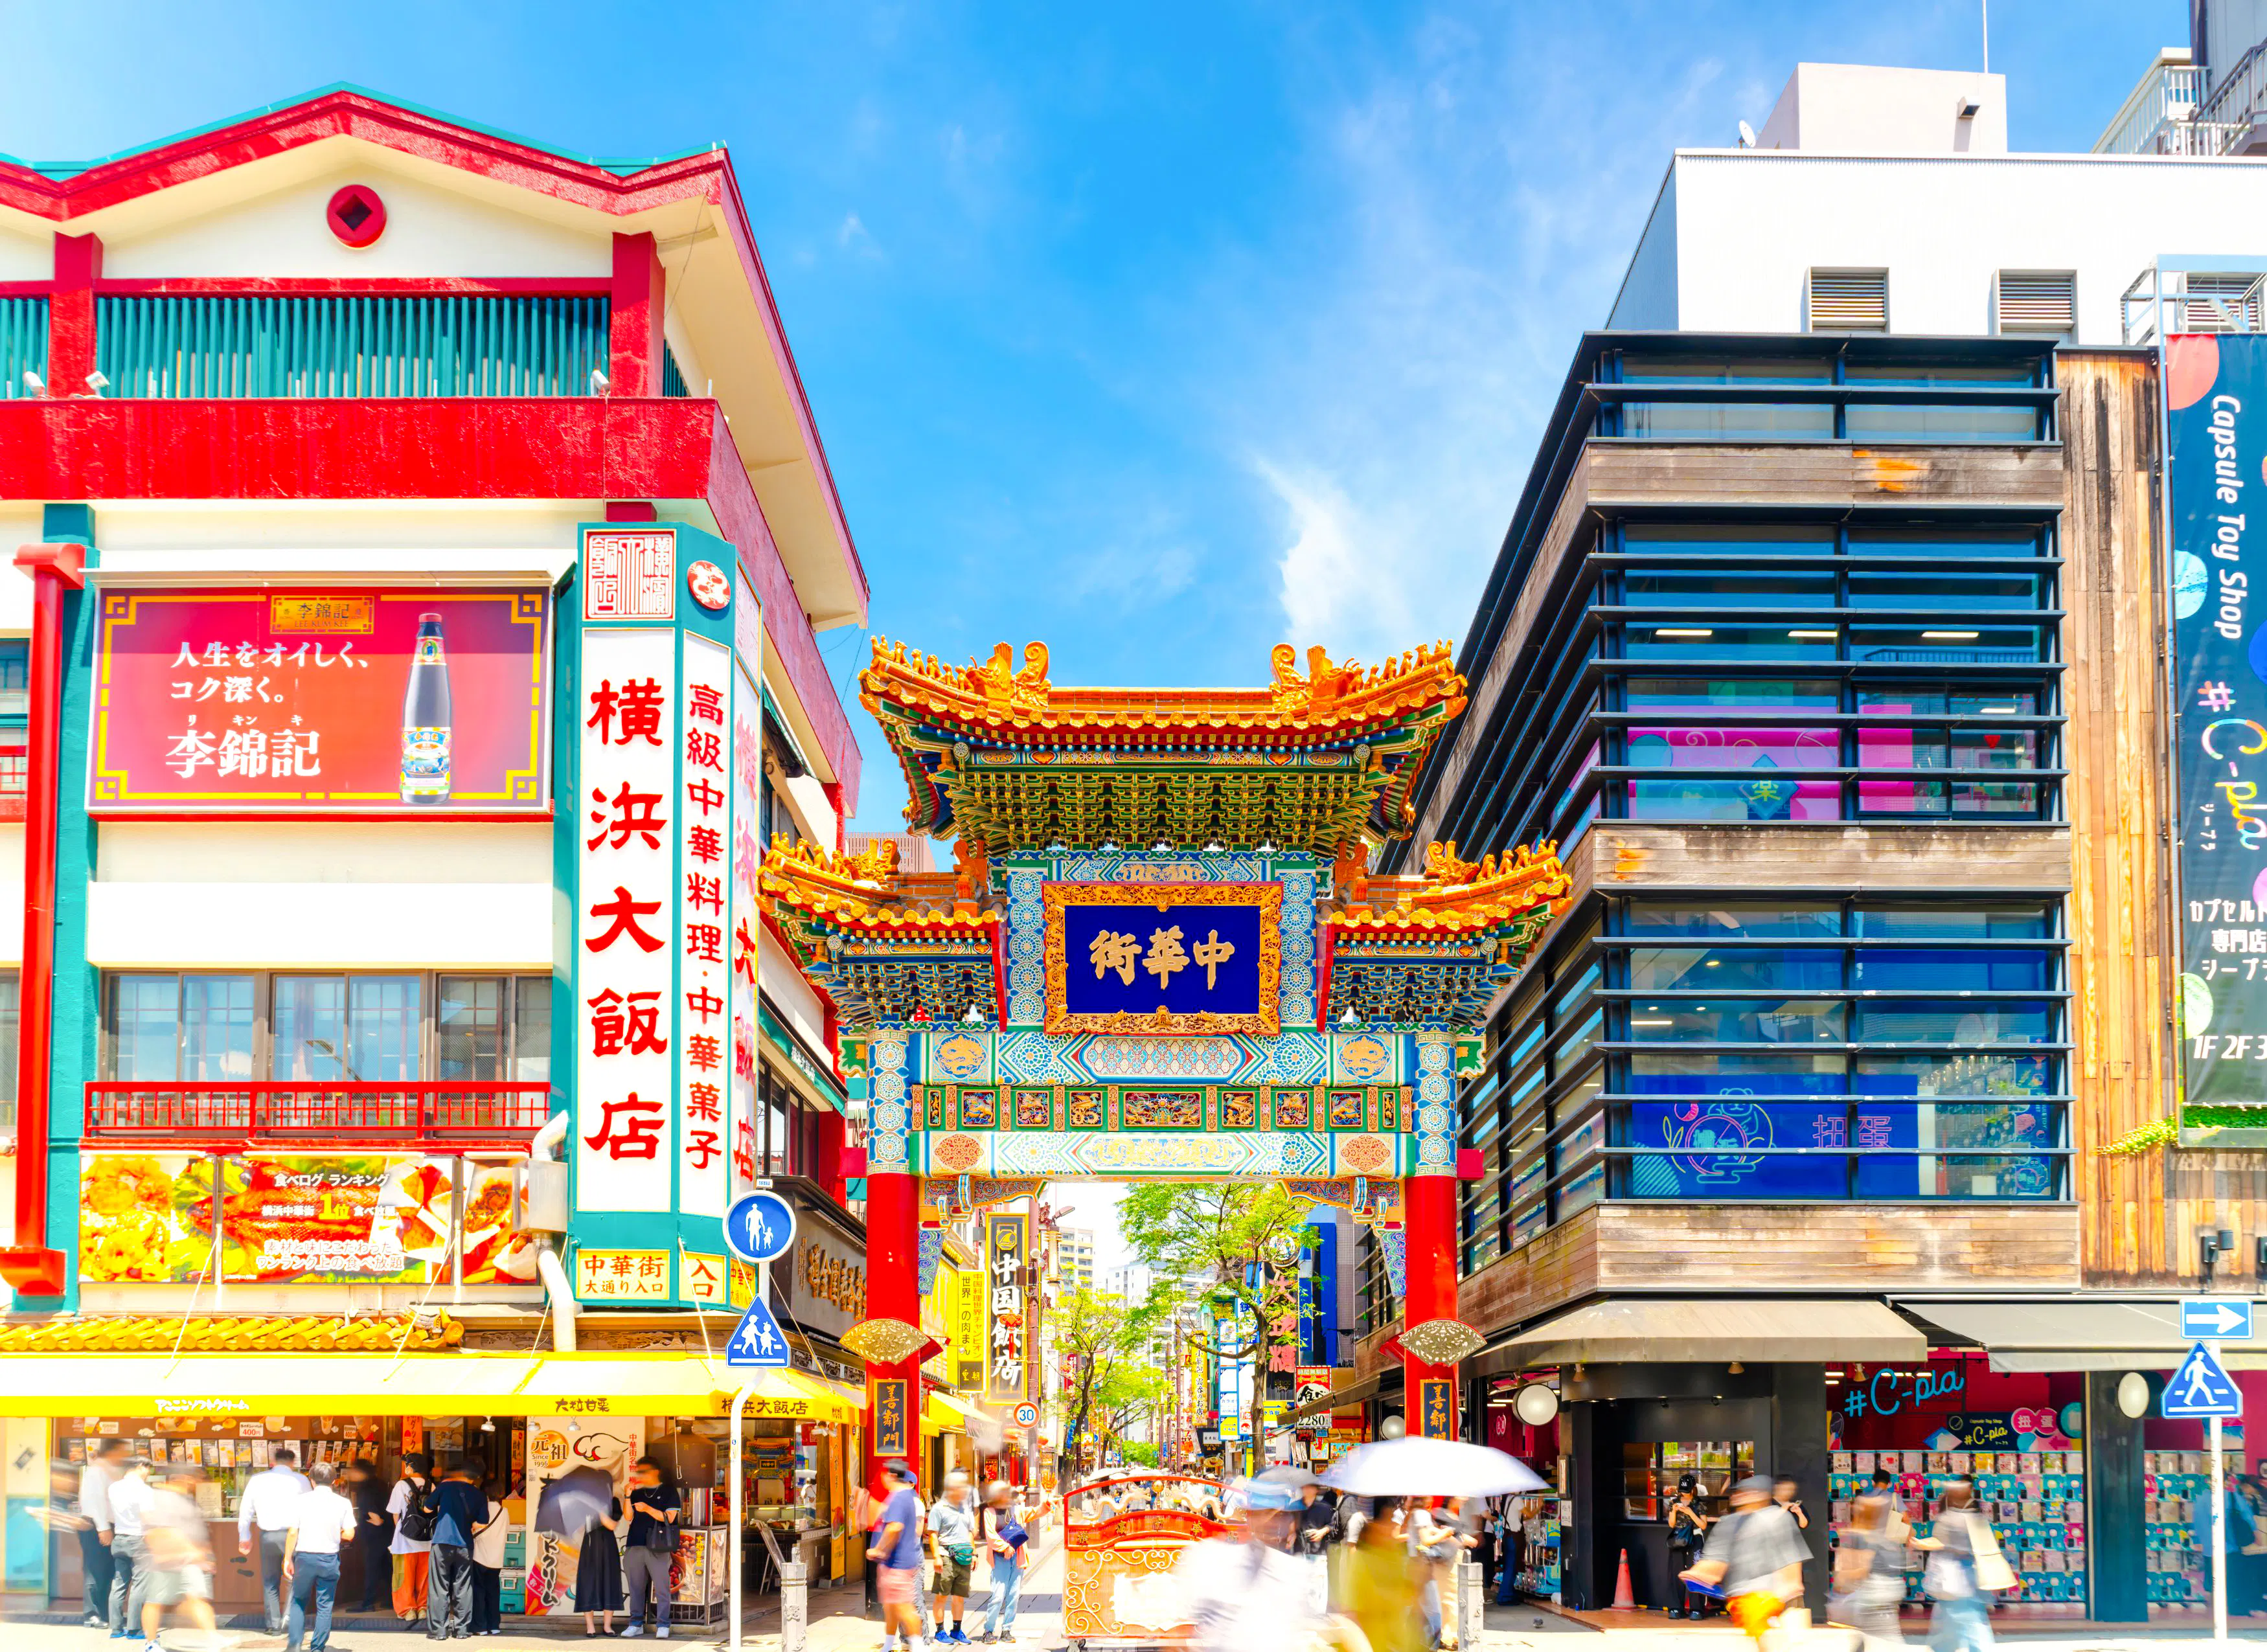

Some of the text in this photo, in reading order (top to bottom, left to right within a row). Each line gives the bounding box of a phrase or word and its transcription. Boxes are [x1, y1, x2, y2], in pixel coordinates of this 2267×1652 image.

[2207, 394, 2248, 640] Capsule Toy Shop
[296, 603, 350, 619] 李錦記
[170, 641, 369, 669] 人生をオイしく、
[170, 676, 284, 703] コク深く。
[233, 715, 258, 726] キン
[290, 715, 303, 725] キ
[165, 729, 322, 778] 李錦記
[584, 677, 668, 1160] 横浜大飯店
[686, 683, 725, 1170] 高級中華料理・中華菓子
[2211, 928, 2267, 953] 専門店
[2202, 957, 2267, 981] シープ
[2193, 1035, 2218, 1059] 1F
[2221, 1035, 2253, 1059] 2F
[274, 1173, 391, 1187] 食べログ ランキング
[318, 1193, 350, 1220] 1位
[265, 1239, 394, 1255] 素材と味にこだわった
[256, 1255, 404, 1271] ワンランク上の食べ放題
[584, 1254, 665, 1278] 中華街
[585, 1280, 663, 1294] 大通り入口
[690, 1258, 718, 1297] 入口
[961, 1276, 971, 1355] 世界一の肉まん
[973, 1274, 983, 1359] 中国料理世界チャンピオン
[1844, 1368, 1965, 1417] #C-pla
[555, 1397, 610, 1413] 大粒甘栗
[1019, 1409, 1034, 1421] 30
[532, 1434, 567, 1460] 元祖
[1964, 1426, 2008, 1445] #C-pla
